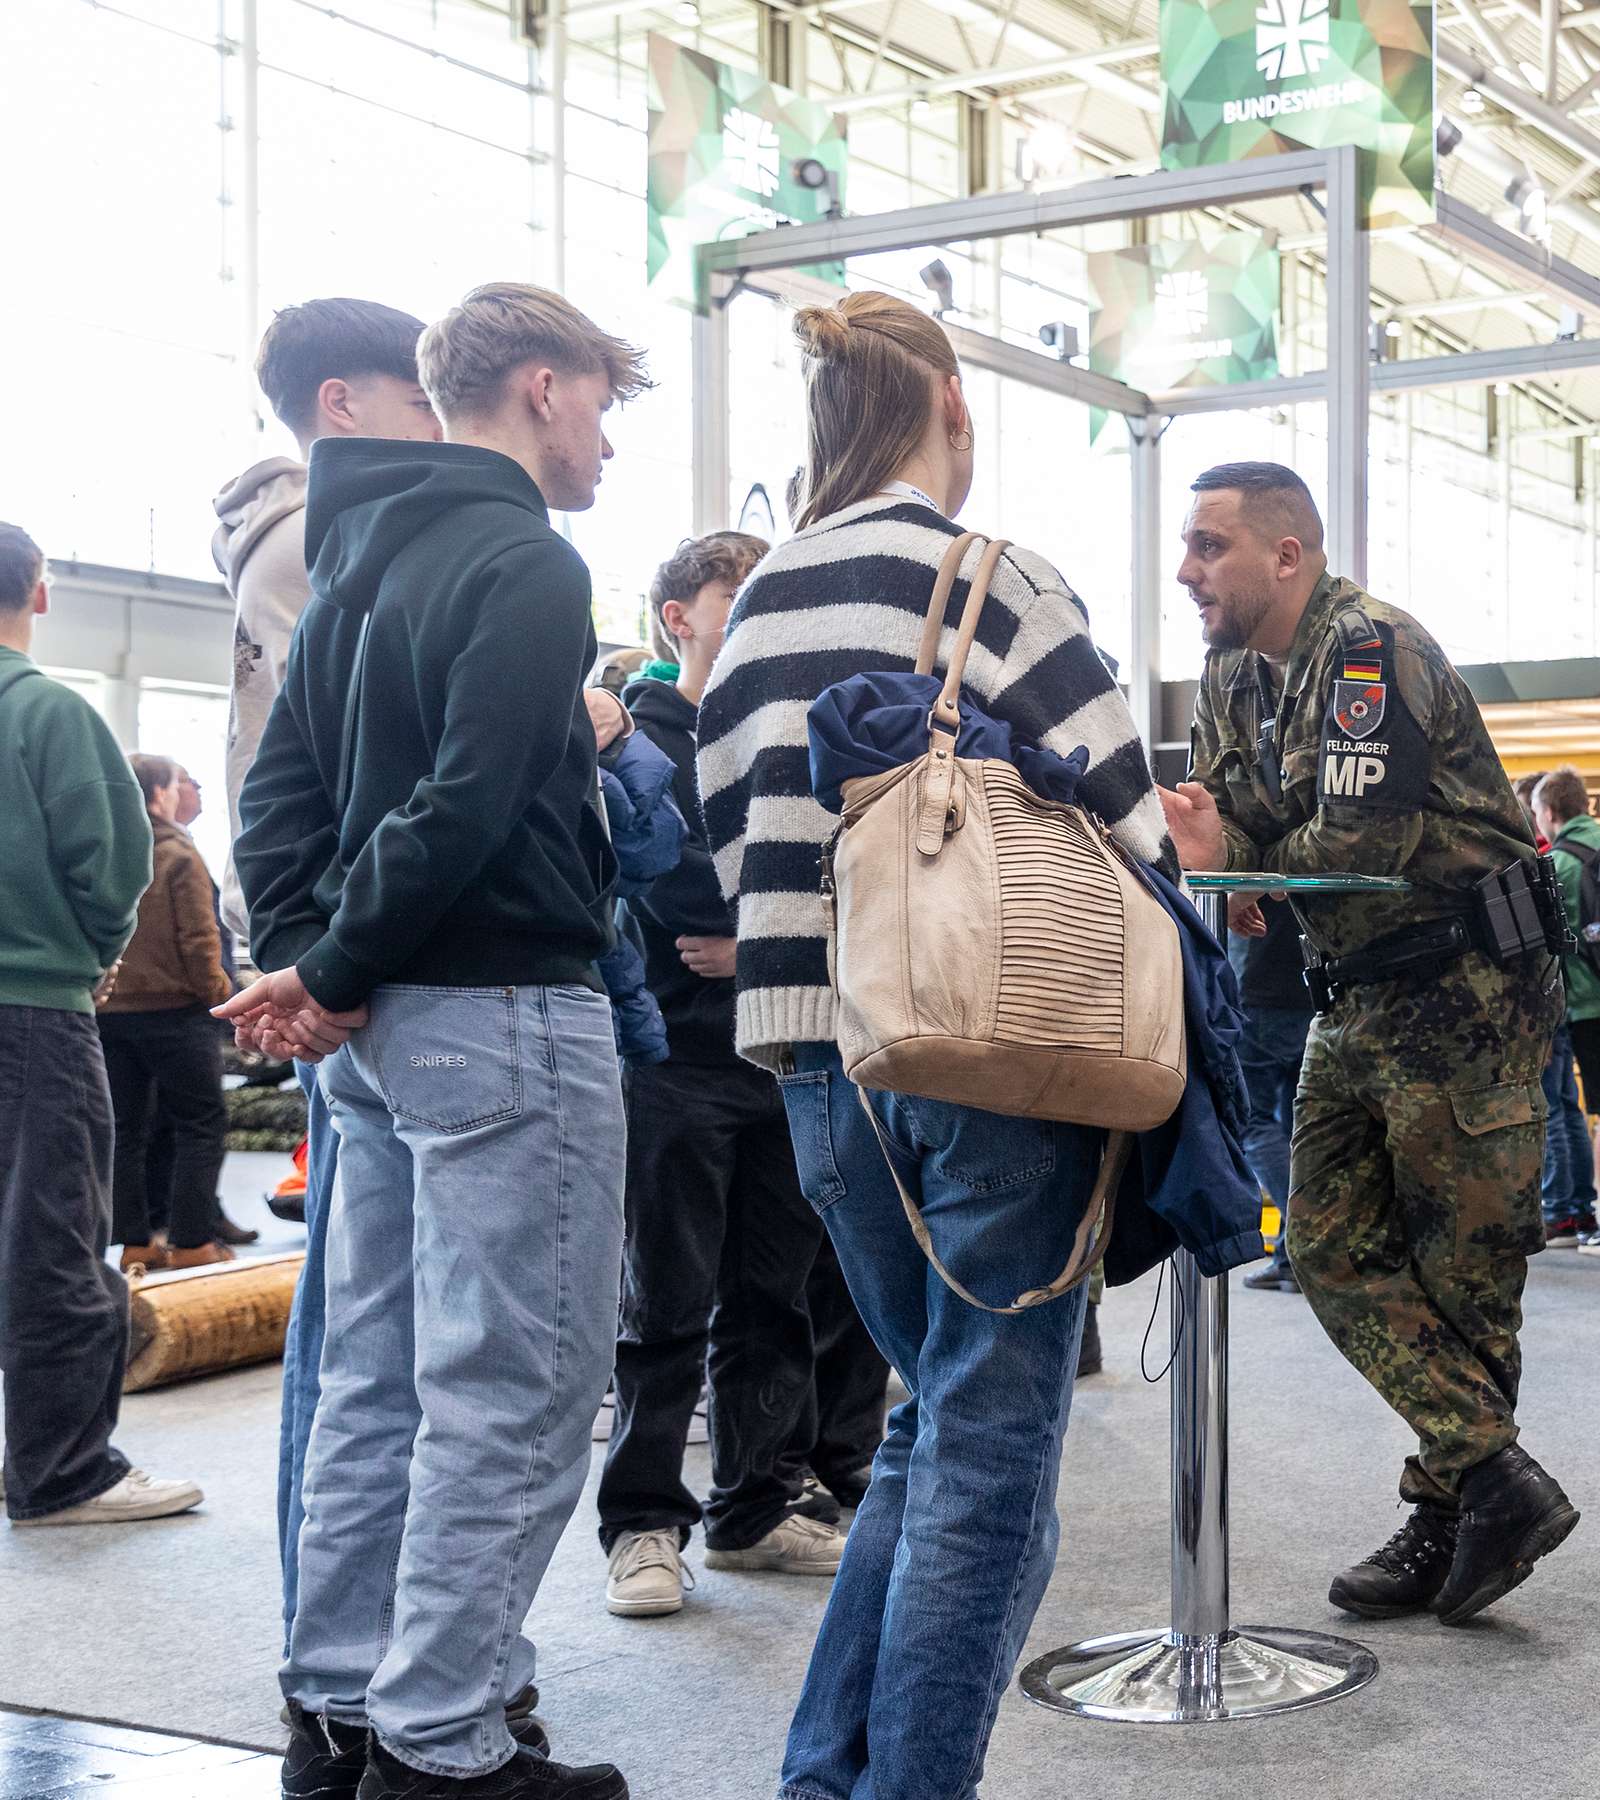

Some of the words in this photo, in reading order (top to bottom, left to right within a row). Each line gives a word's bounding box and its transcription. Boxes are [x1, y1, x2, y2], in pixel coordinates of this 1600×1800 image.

[1223, 79, 1365, 124] BUNDESWEHR
[1324, 755, 1386, 797] MP
[410, 1055, 467, 1067] SNIPES
